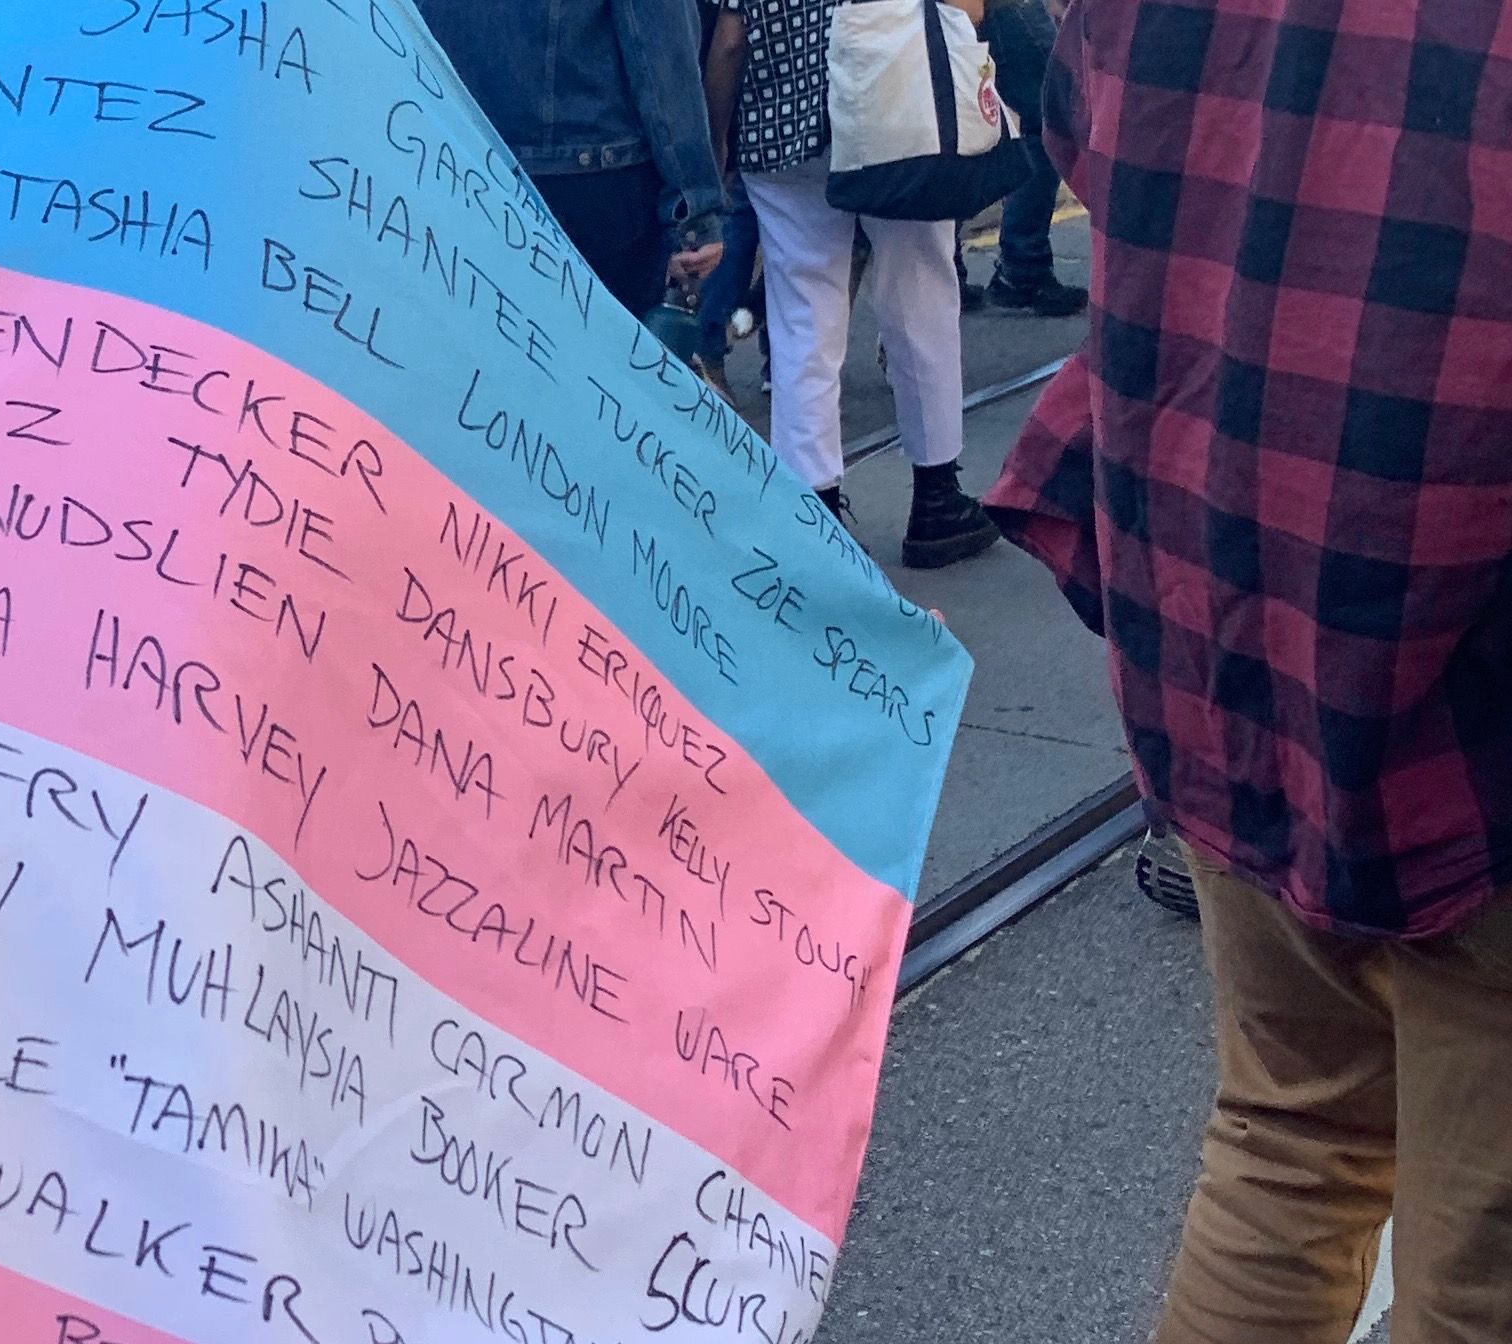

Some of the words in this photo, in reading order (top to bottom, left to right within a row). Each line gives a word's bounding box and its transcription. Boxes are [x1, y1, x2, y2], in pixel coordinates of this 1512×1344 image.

[299, 157, 559, 384] SHANTEE
[587, 375, 717, 539] TUCKER
[387, 100, 594, 329] GARDEN
[262, 238, 405, 369] BELL
[457, 369, 610, 545] LONDON
[632, 528, 739, 687] MOORE
[730, 546, 807, 634] ZOE
[813, 626, 934, 746] SPEARS
[441, 502, 557, 647] NIKKI
[577, 623, 729, 796] ERIQUEZ
[167, 436, 354, 583] TYDIE
[396, 566, 641, 813] DANSBURY
[657, 793, 730, 921] KELLY
[366, 663, 507, 818] DANA
[528, 793, 717, 974] MARTIN
[85, 609, 327, 853] HARVEY
[354, 801, 630, 1026] JAZZALINE
[675, 1009, 796, 1131] WARE
[211, 835, 398, 1049] ASHANTI
[431, 1019, 652, 1191] CARMON
[85, 906, 366, 1128] MUHLAYSIA
[410, 1095, 602, 1272] BOOKER
